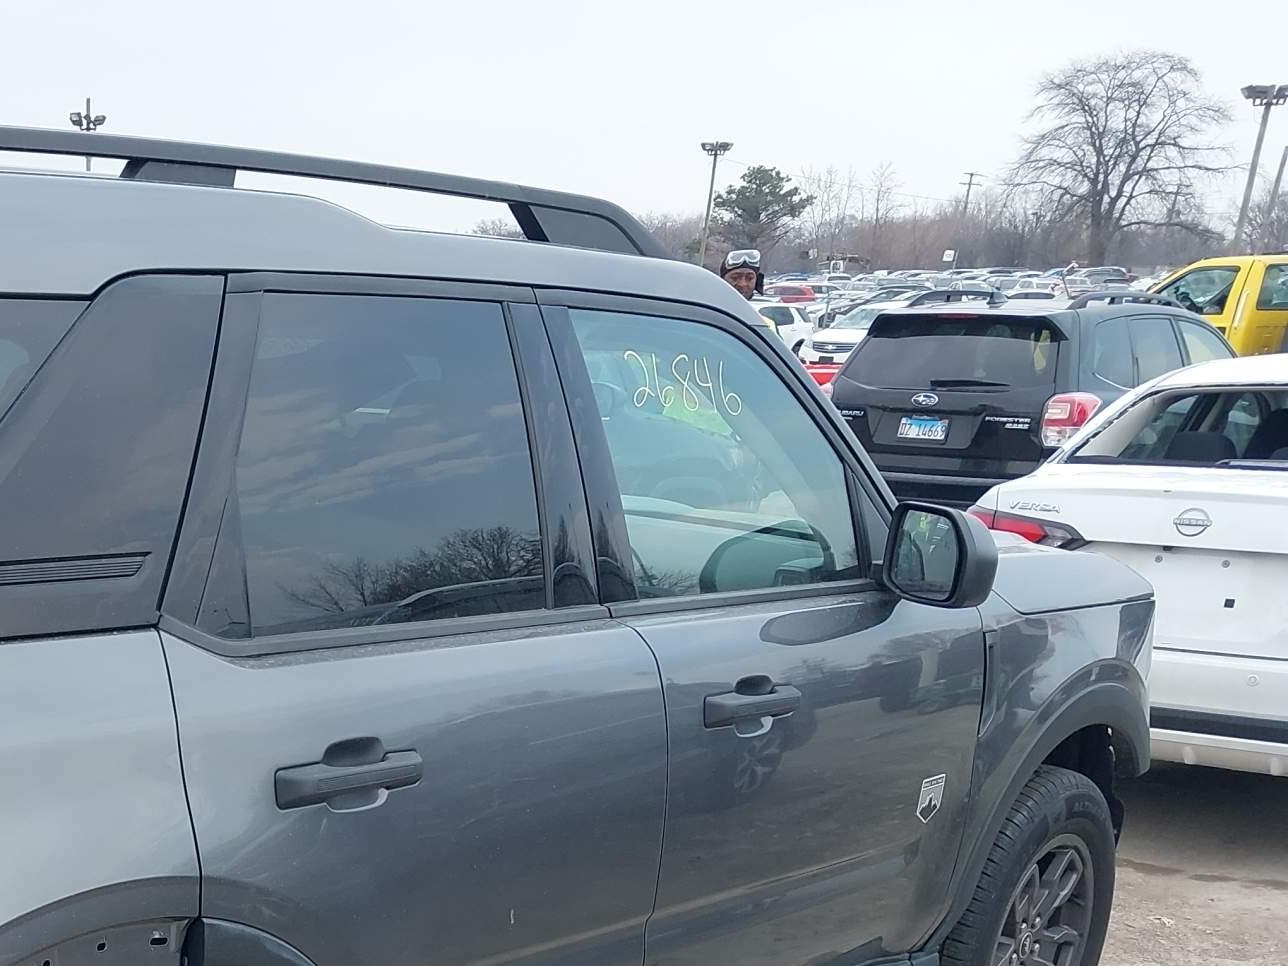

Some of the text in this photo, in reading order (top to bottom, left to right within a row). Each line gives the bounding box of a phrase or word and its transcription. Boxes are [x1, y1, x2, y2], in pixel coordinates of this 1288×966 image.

[623, 350, 742, 416] 26846
[915, 423, 947, 438] 14669
[1009, 501, 1061, 514] VERSA
[1173, 517, 1212, 527] NISSAN
